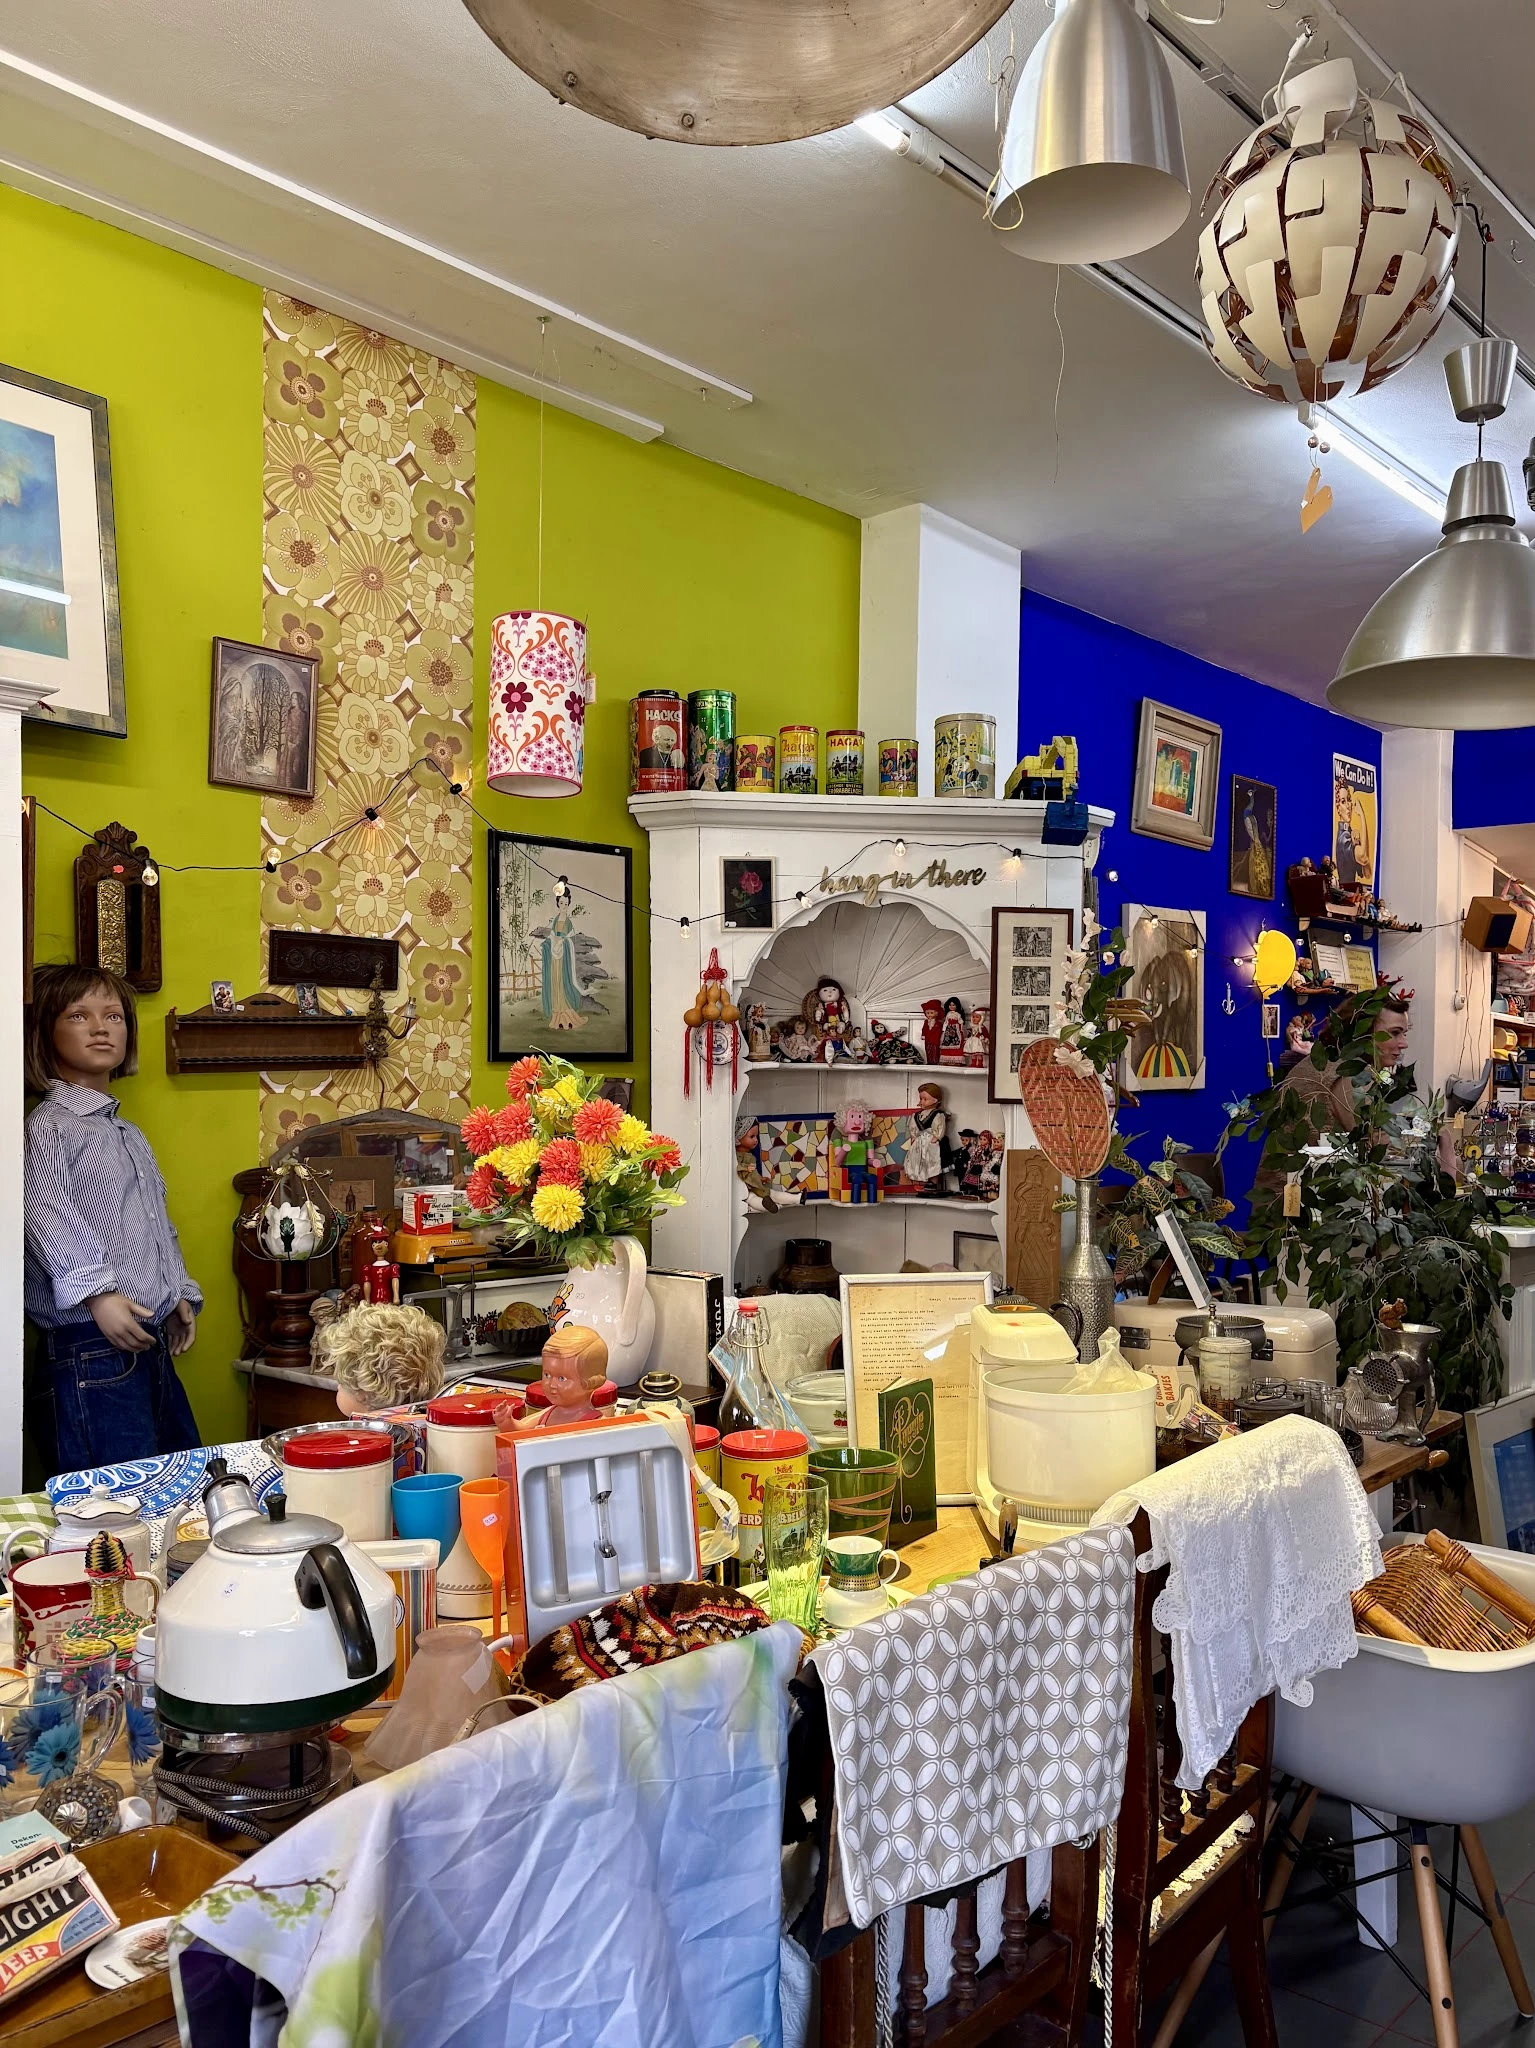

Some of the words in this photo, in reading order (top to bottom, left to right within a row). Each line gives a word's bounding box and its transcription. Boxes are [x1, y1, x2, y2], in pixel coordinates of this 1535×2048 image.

[645, 709, 681, 722] HACKS
[1335, 760, 1344, 778] We
[1345, 764, 1356, 782] Can
[1357, 768, 1365, 785] Do
[819, 865, 880, 907] hang
[890, 870, 918, 890] in
[927, 858, 987, 888] there
[1161, 1375, 1175, 1401] BAKJES
[11, 1833, 42, 1845] Deken-
